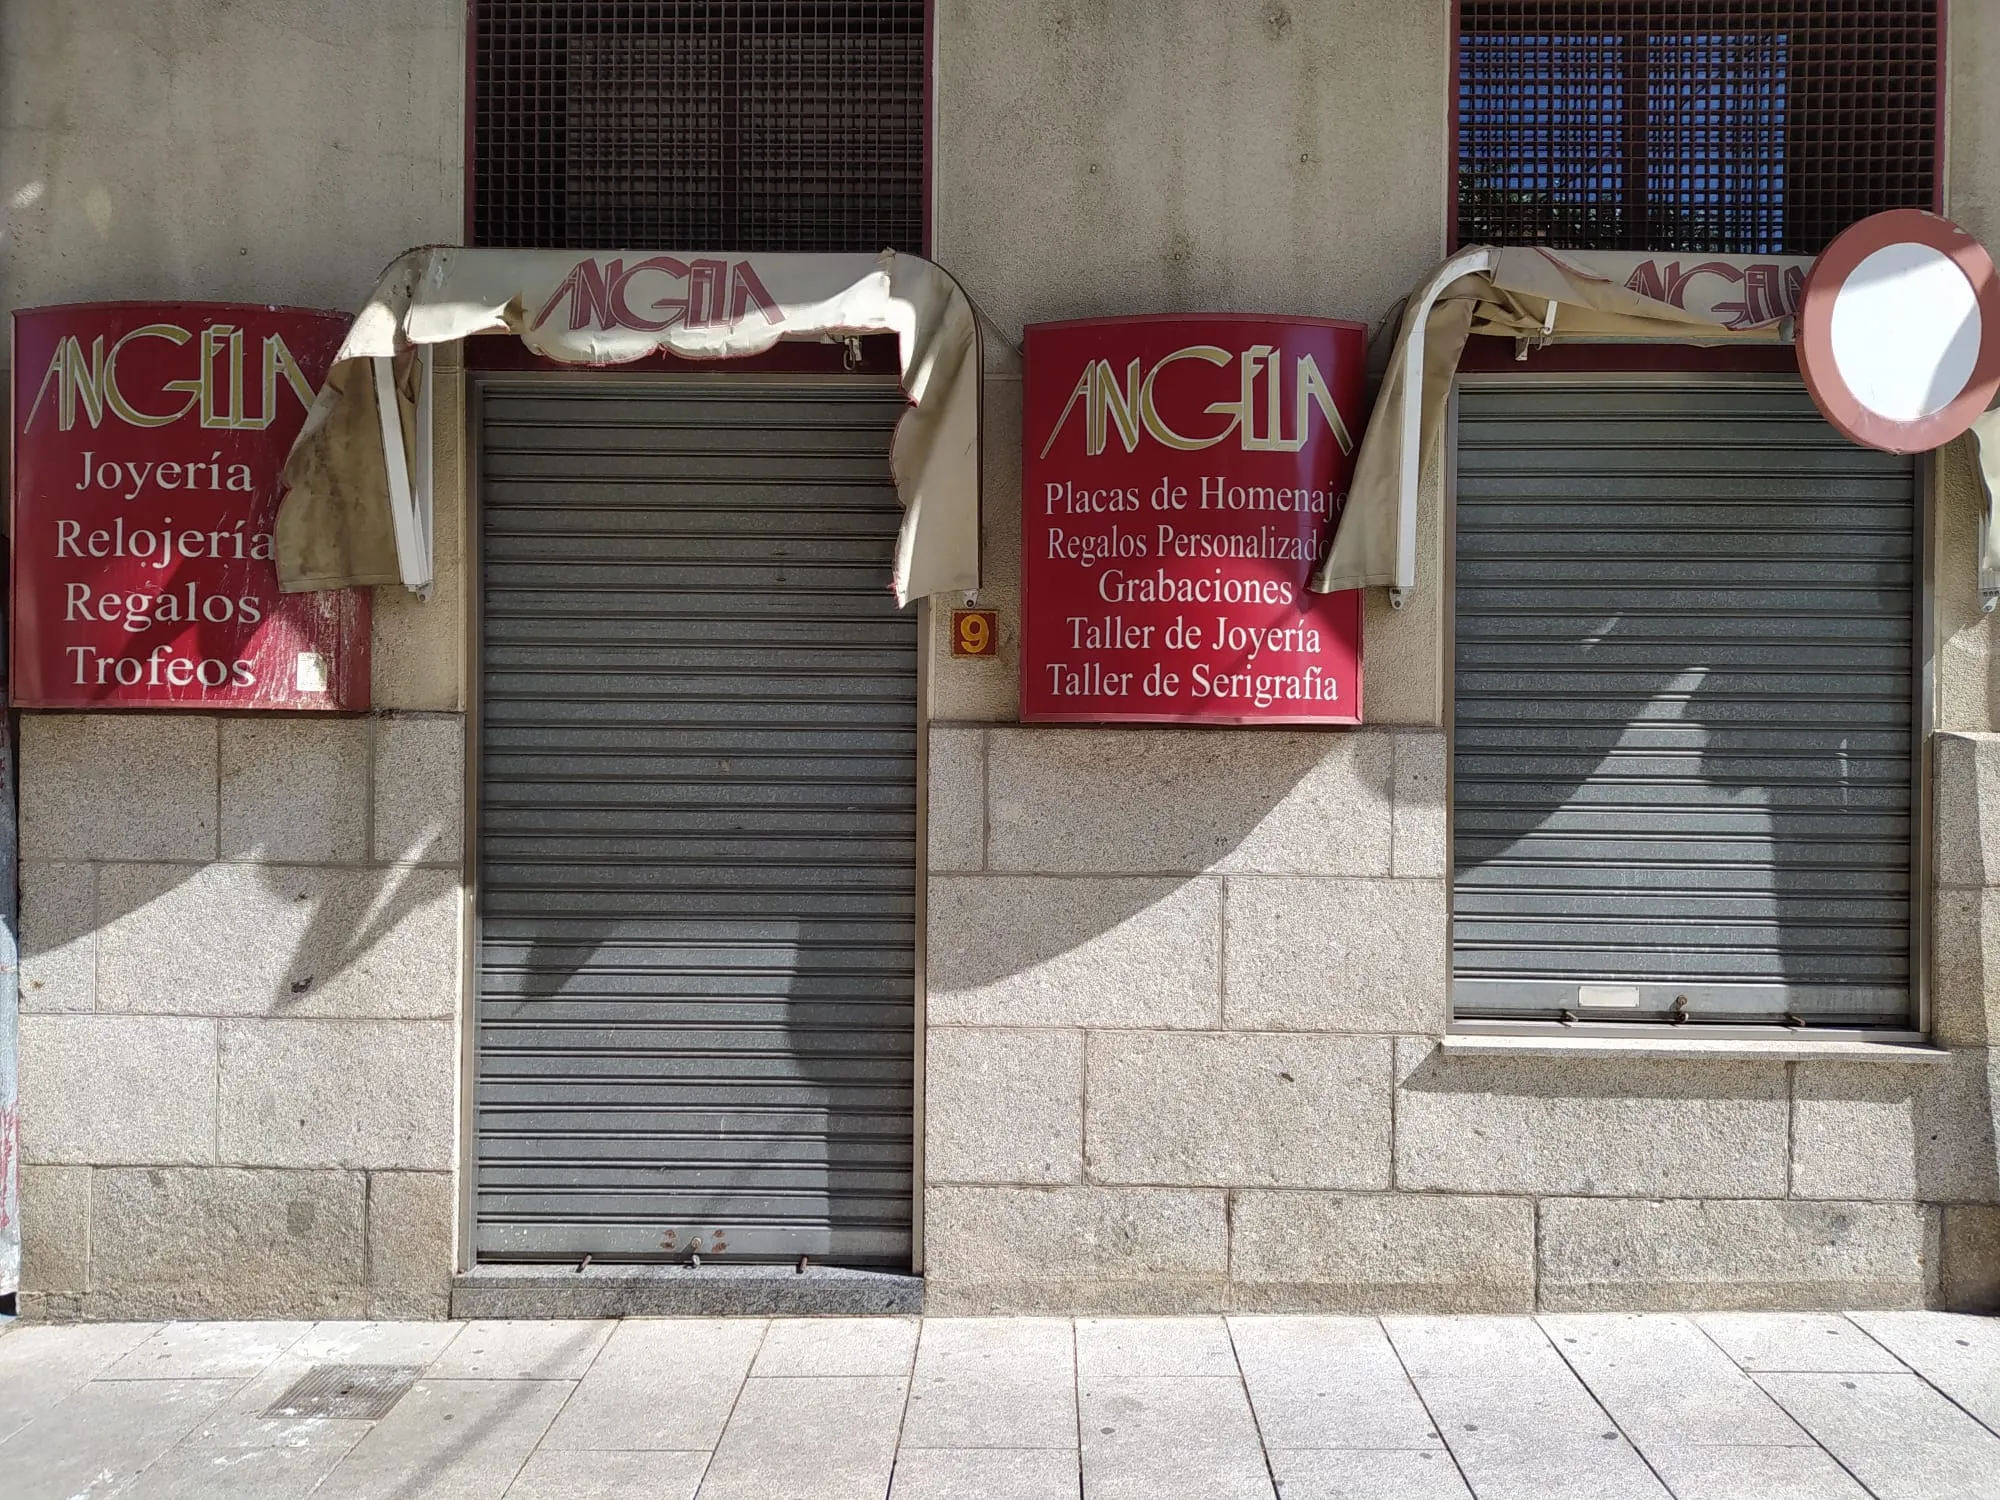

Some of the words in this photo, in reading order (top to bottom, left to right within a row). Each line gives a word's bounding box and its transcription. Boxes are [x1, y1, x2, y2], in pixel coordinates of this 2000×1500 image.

[1040, 344, 1354, 459] ANGELA
[75, 450, 255, 500] Joyería
[1044, 481, 1140, 515] Placas
[1151, 476, 1188, 510] de
[54, 517, 275, 569] Relojería
[1047, 525, 1147, 568] Regalos
[1157, 524, 1330, 562] Personalizado
[64, 582, 261, 633] Regalos
[1099, 568, 1293, 605] Grabaciones
[960, 614, 990, 653] 9
[1066, 615, 1155, 650] Taller
[1165, 615, 1201, 650] de
[1212, 616, 1321, 661] Joyería
[65, 645, 257, 688] Trofeos
[1046, 662, 1133, 697] Taller
[1142, 662, 1180, 697] de
[1190, 664, 1338, 707] Serigrafía
